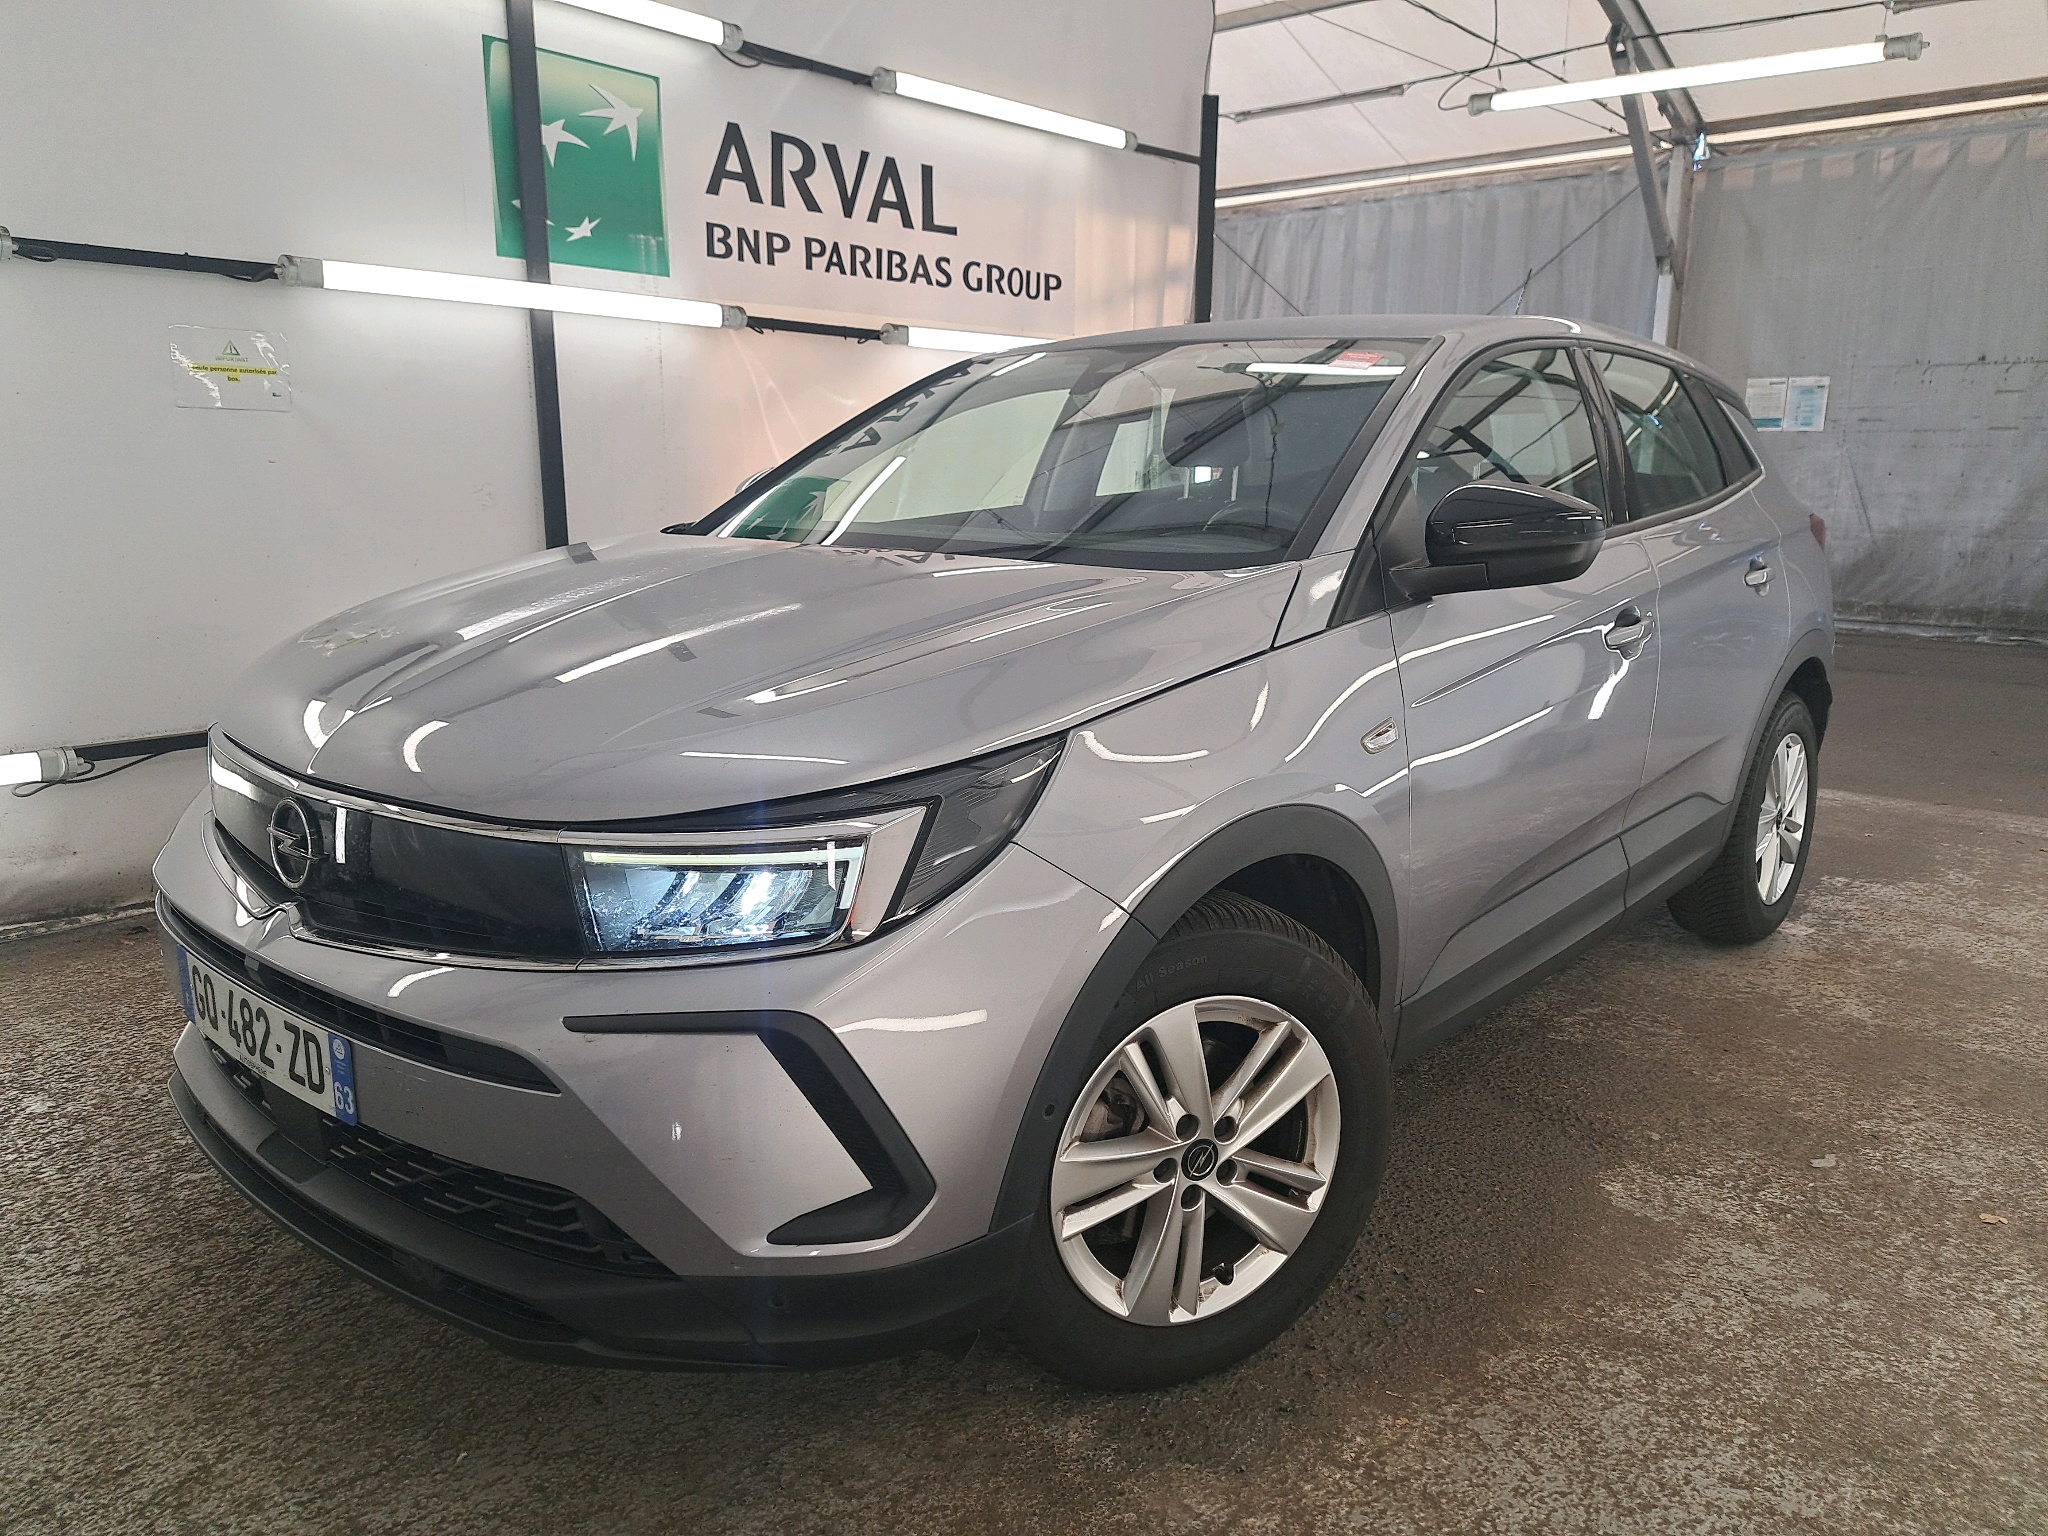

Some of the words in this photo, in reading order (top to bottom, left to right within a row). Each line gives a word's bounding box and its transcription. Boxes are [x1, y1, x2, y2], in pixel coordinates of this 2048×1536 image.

[705, 121, 958, 236] ARVAL
[705, 222, 791, 266] BNP
[804, 236, 952, 288] PARIBAS
[962, 261, 1062, 301] GROUP
[1158, 955, 1209, 979] Season
[334, 1081, 354, 1115] 63
